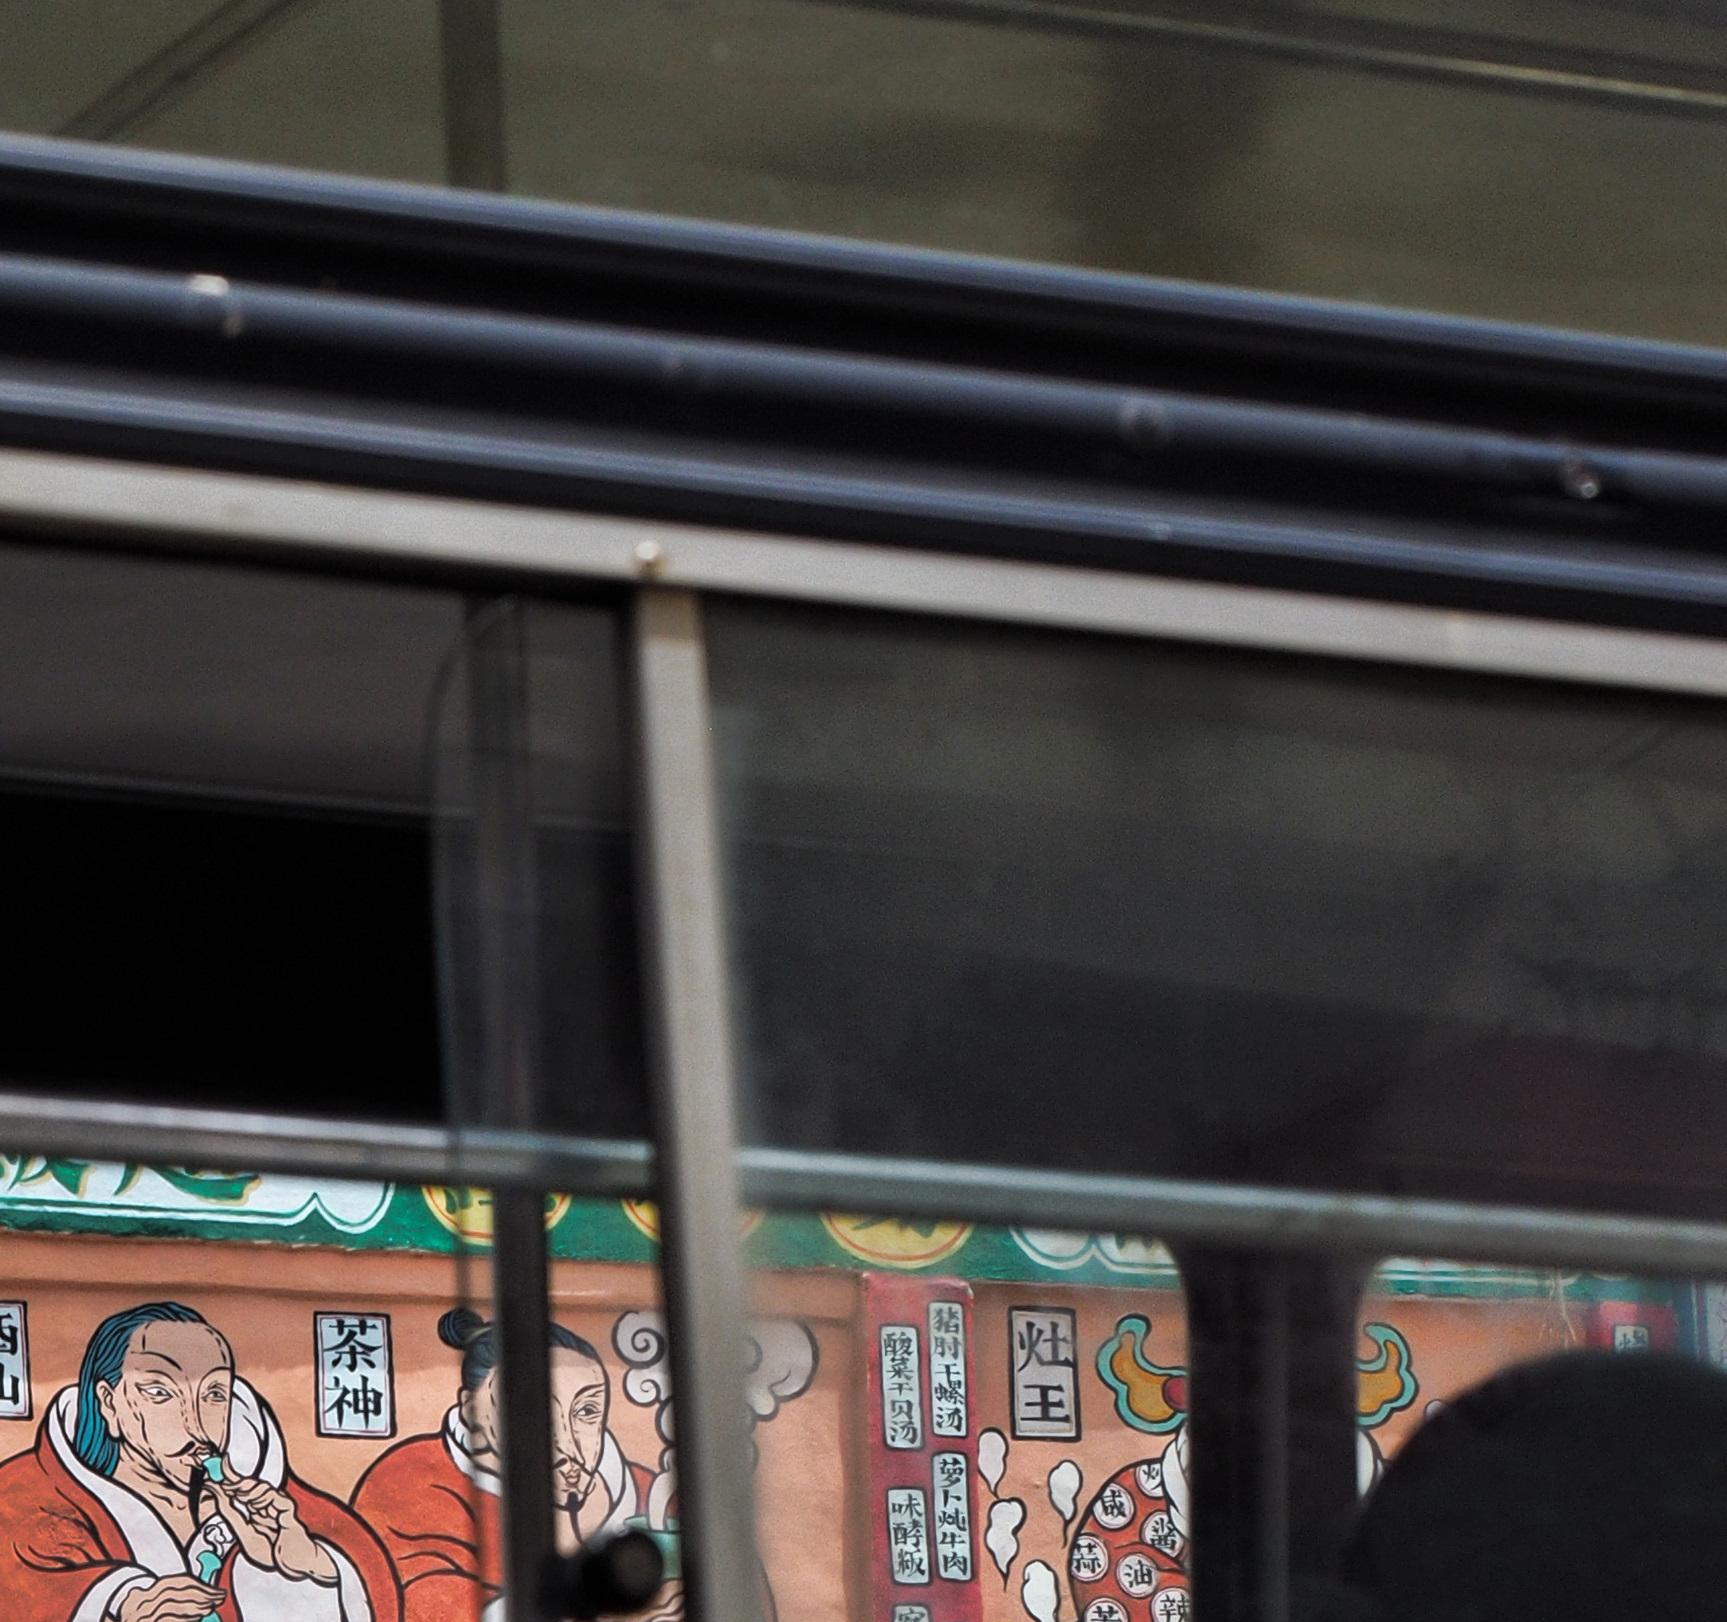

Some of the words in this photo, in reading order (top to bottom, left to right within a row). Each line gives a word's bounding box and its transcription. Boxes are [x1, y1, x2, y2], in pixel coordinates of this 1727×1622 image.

[323, 1319, 384, 1430] 茶神
[1018, 1320, 1074, 1424] 灶王
[939, 1457, 968, 1576] 萝卜炖牛肉
[1124, 1560, 1153, 1588] 油
